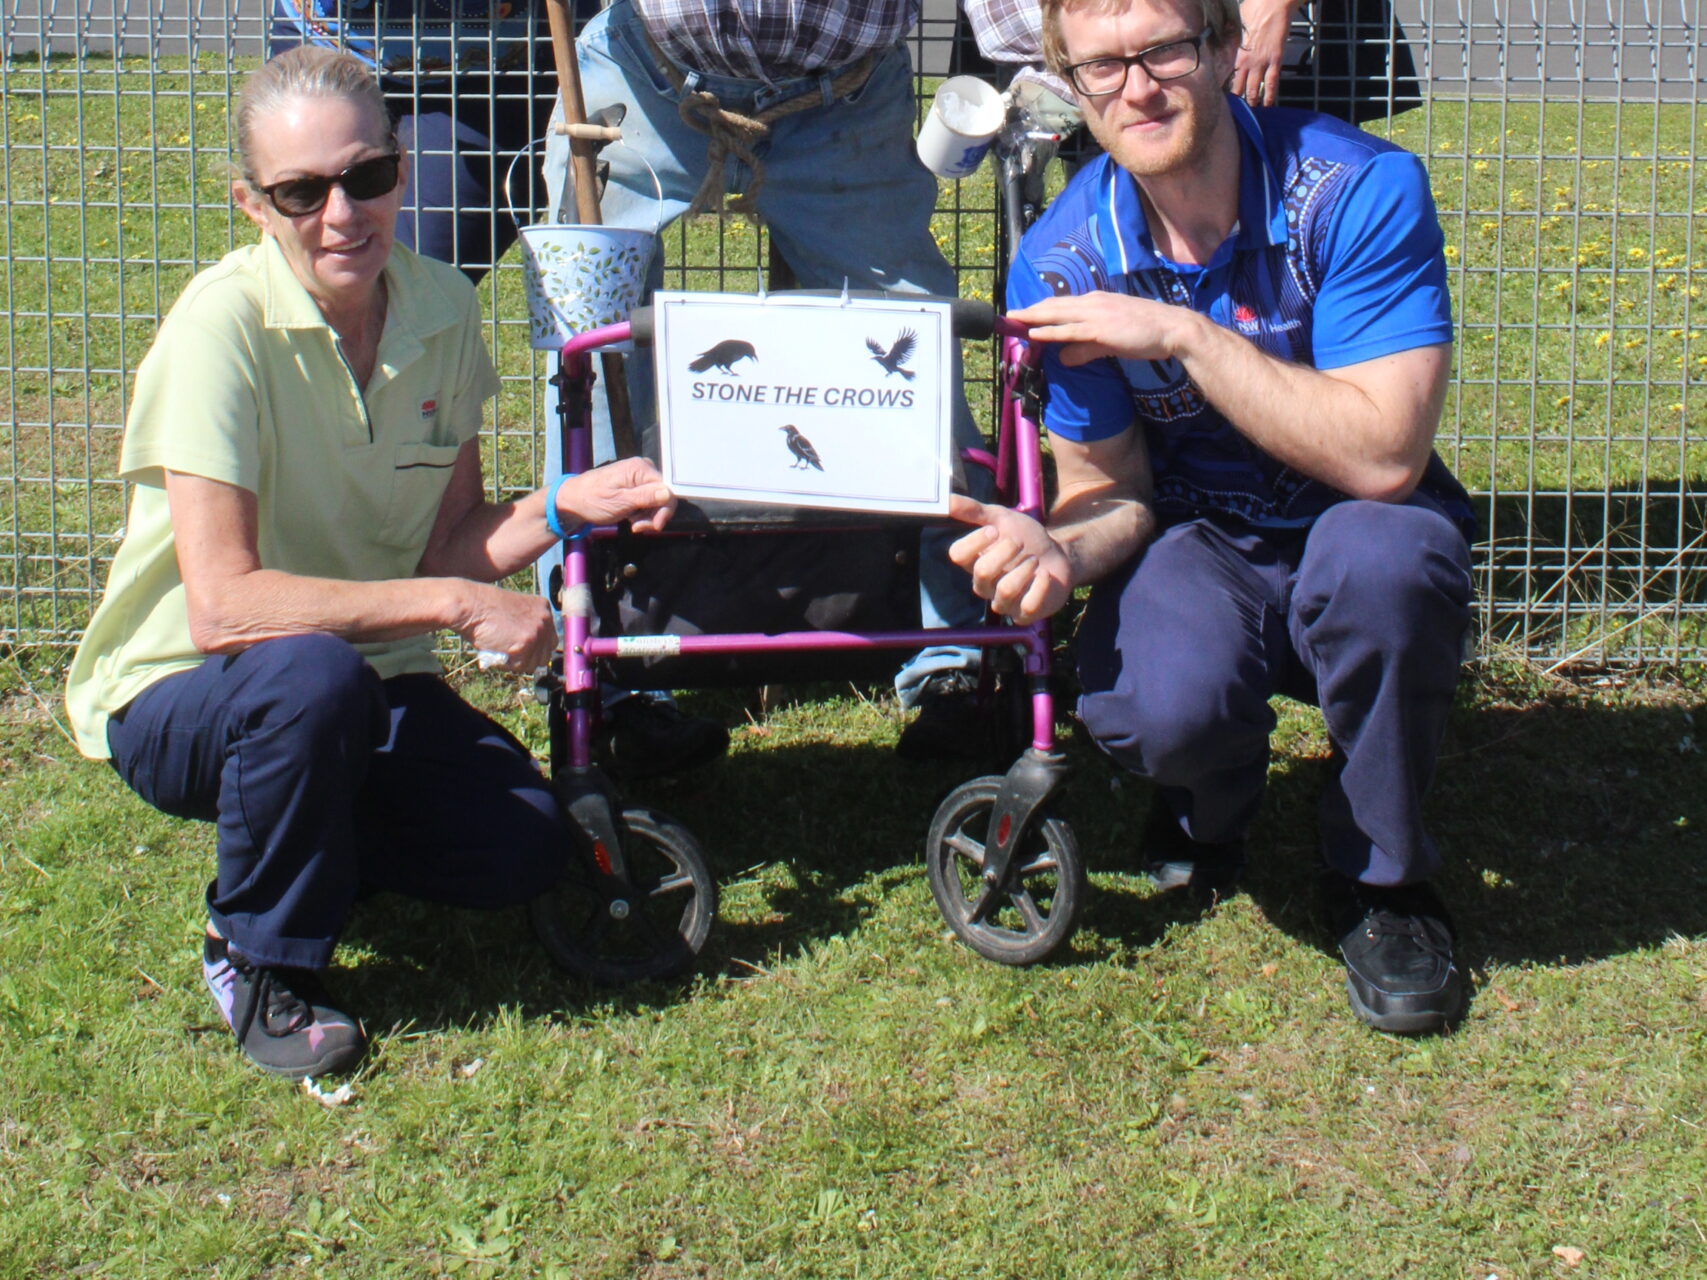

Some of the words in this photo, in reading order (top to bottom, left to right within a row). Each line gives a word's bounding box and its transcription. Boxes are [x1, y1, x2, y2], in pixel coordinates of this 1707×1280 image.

[1237, 320, 1259, 332] NSW
[1268, 319, 1302, 333] Health
[691, 381, 768, 403] STONE
[773, 385, 819, 405] THE
[822, 387, 915, 408] CROWS
